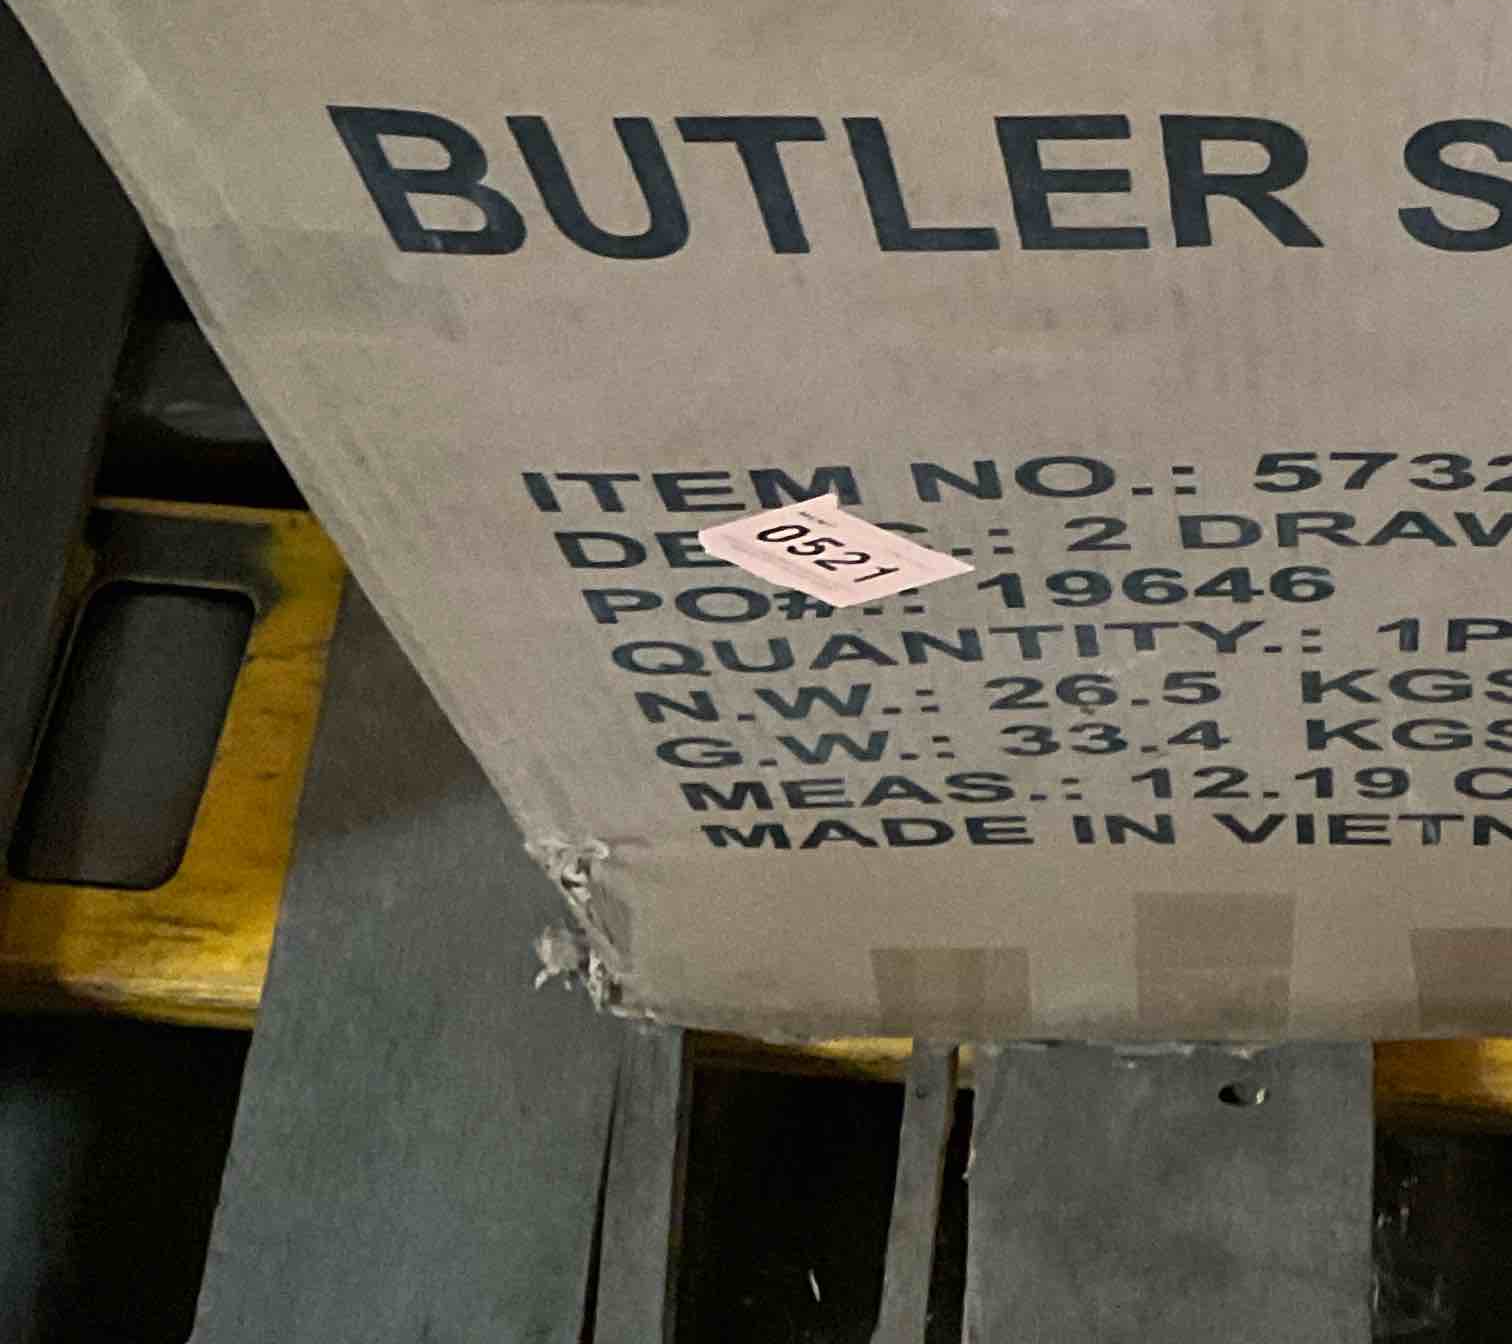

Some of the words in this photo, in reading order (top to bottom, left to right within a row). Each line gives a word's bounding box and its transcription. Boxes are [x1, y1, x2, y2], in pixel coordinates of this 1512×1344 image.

[325, 105, 1325, 260] BUTLER
[522, 465, 862, 512] ITEM
[911, 456, 1197, 502] NO.:
[553, 522, 1015, 570] DE.:
[1063, 516, 1132, 552] 2
[757, 524, 899, 583] 0521
[977, 566, 1336, 610] 19646
[611, 620, 1322, 676] QUANTITY.:
[634, 683, 940, 723] N.W.:
[983, 671, 1222, 711] 26.5
[655, 730, 955, 769] G.W.:
[1000, 719, 1231, 757] 33.4
[680, 770, 1081, 811] MEAS.:
[1130, 766, 1409, 801] 12.19
[700, 814, 1034, 850] MADE
[1071, 813, 1177, 845] IN
